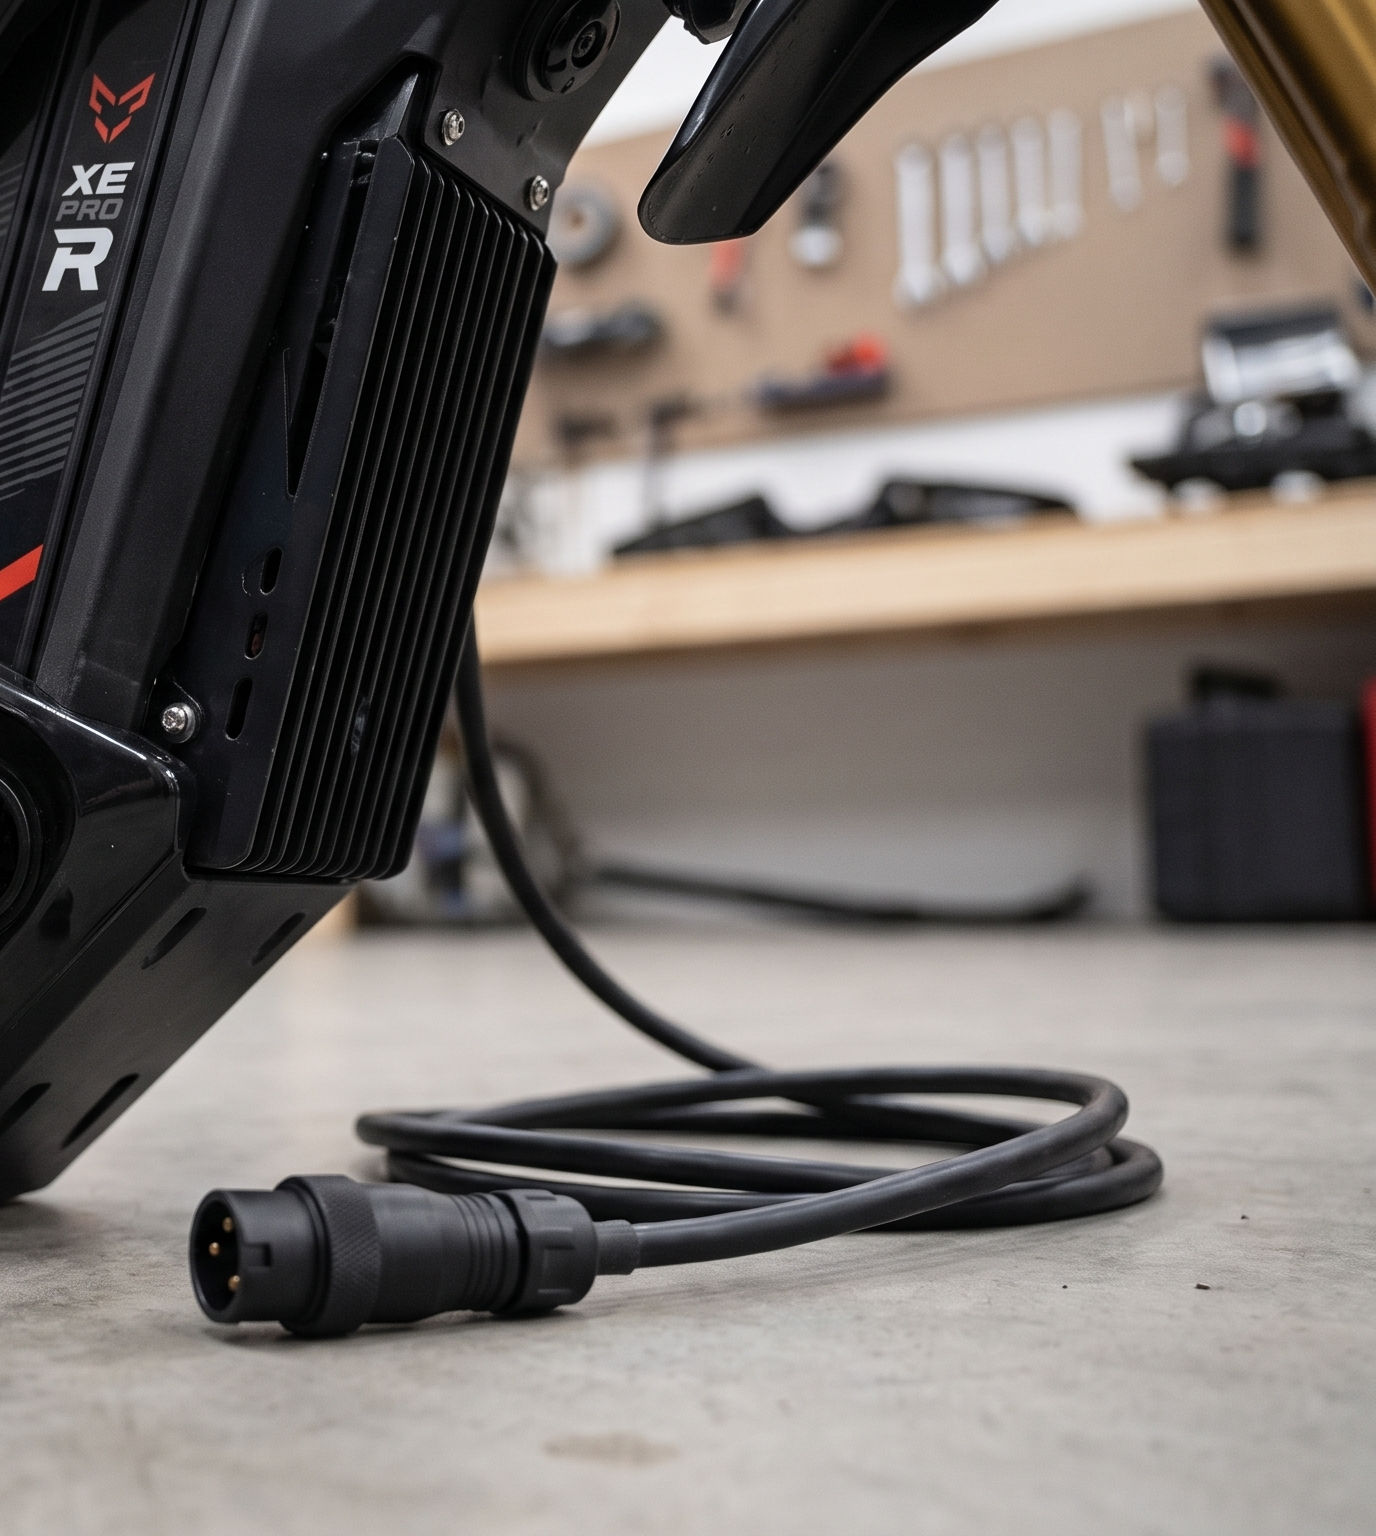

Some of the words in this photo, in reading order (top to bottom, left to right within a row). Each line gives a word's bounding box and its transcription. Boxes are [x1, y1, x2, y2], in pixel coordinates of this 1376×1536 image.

[62, 161, 135, 197] XE
[55, 198, 124, 222] PRO
[42, 227, 114, 291] R
